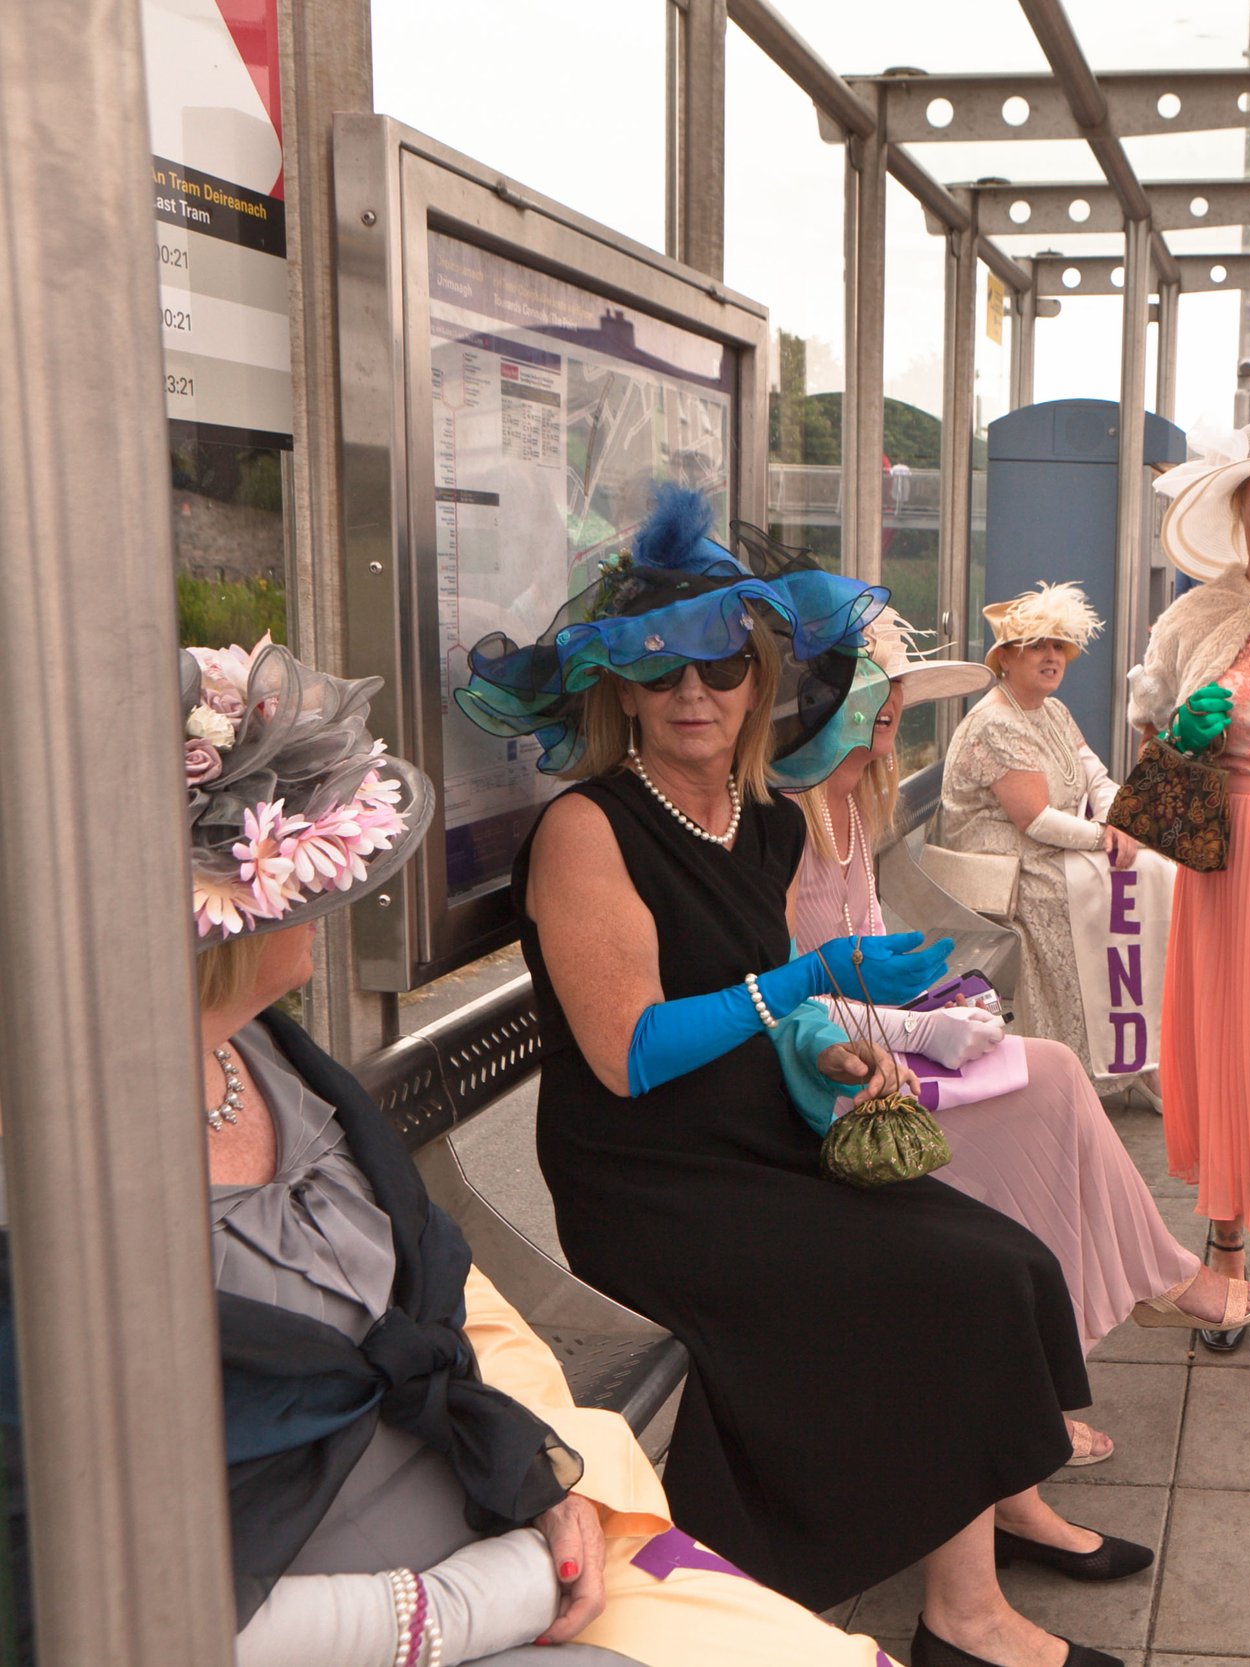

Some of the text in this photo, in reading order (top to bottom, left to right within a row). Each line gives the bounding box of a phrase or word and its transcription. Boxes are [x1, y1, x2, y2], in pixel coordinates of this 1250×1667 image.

[154, 196, 211, 225] ast Tram
[168, 171, 201, 198] Tram
[203, 183, 268, 220] Deireanach
[163, 374, 194, 397] 3:21
[1107, 847, 1148, 1074] END
